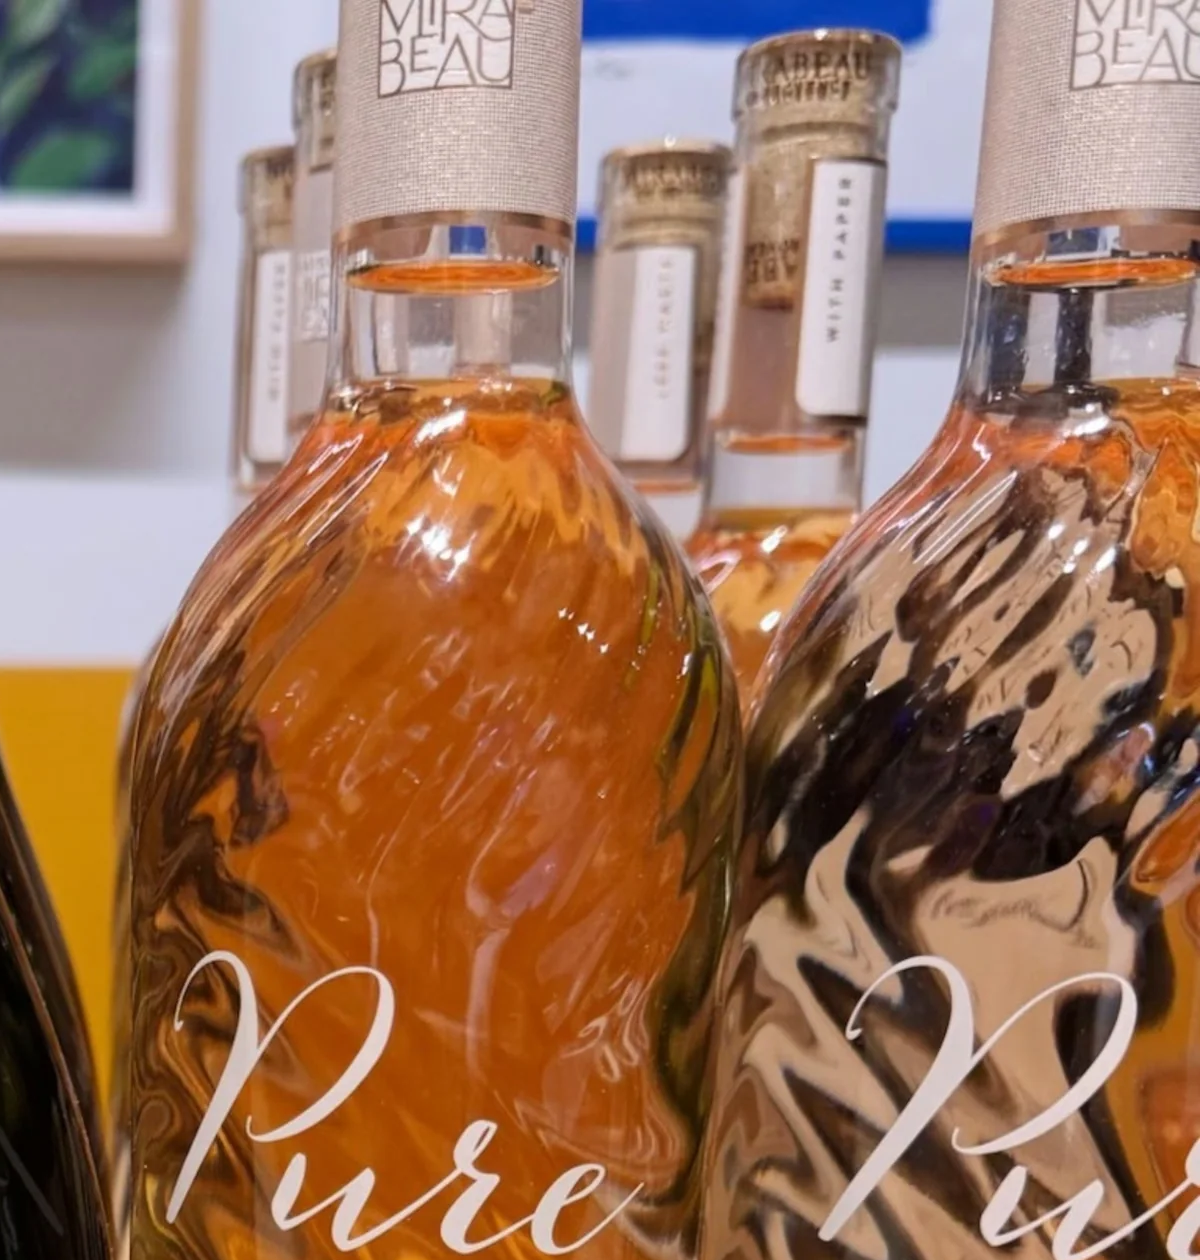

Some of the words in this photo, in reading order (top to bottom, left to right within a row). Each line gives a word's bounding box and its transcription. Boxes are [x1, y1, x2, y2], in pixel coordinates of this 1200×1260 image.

[1076, 0, 1200, 36] MIR
[378, 34, 516, 99] BEAU
[833, 175, 853, 262] PAPER
[825, 276, 845, 345] WITH
[166, 950, 645, 1256] Pure
